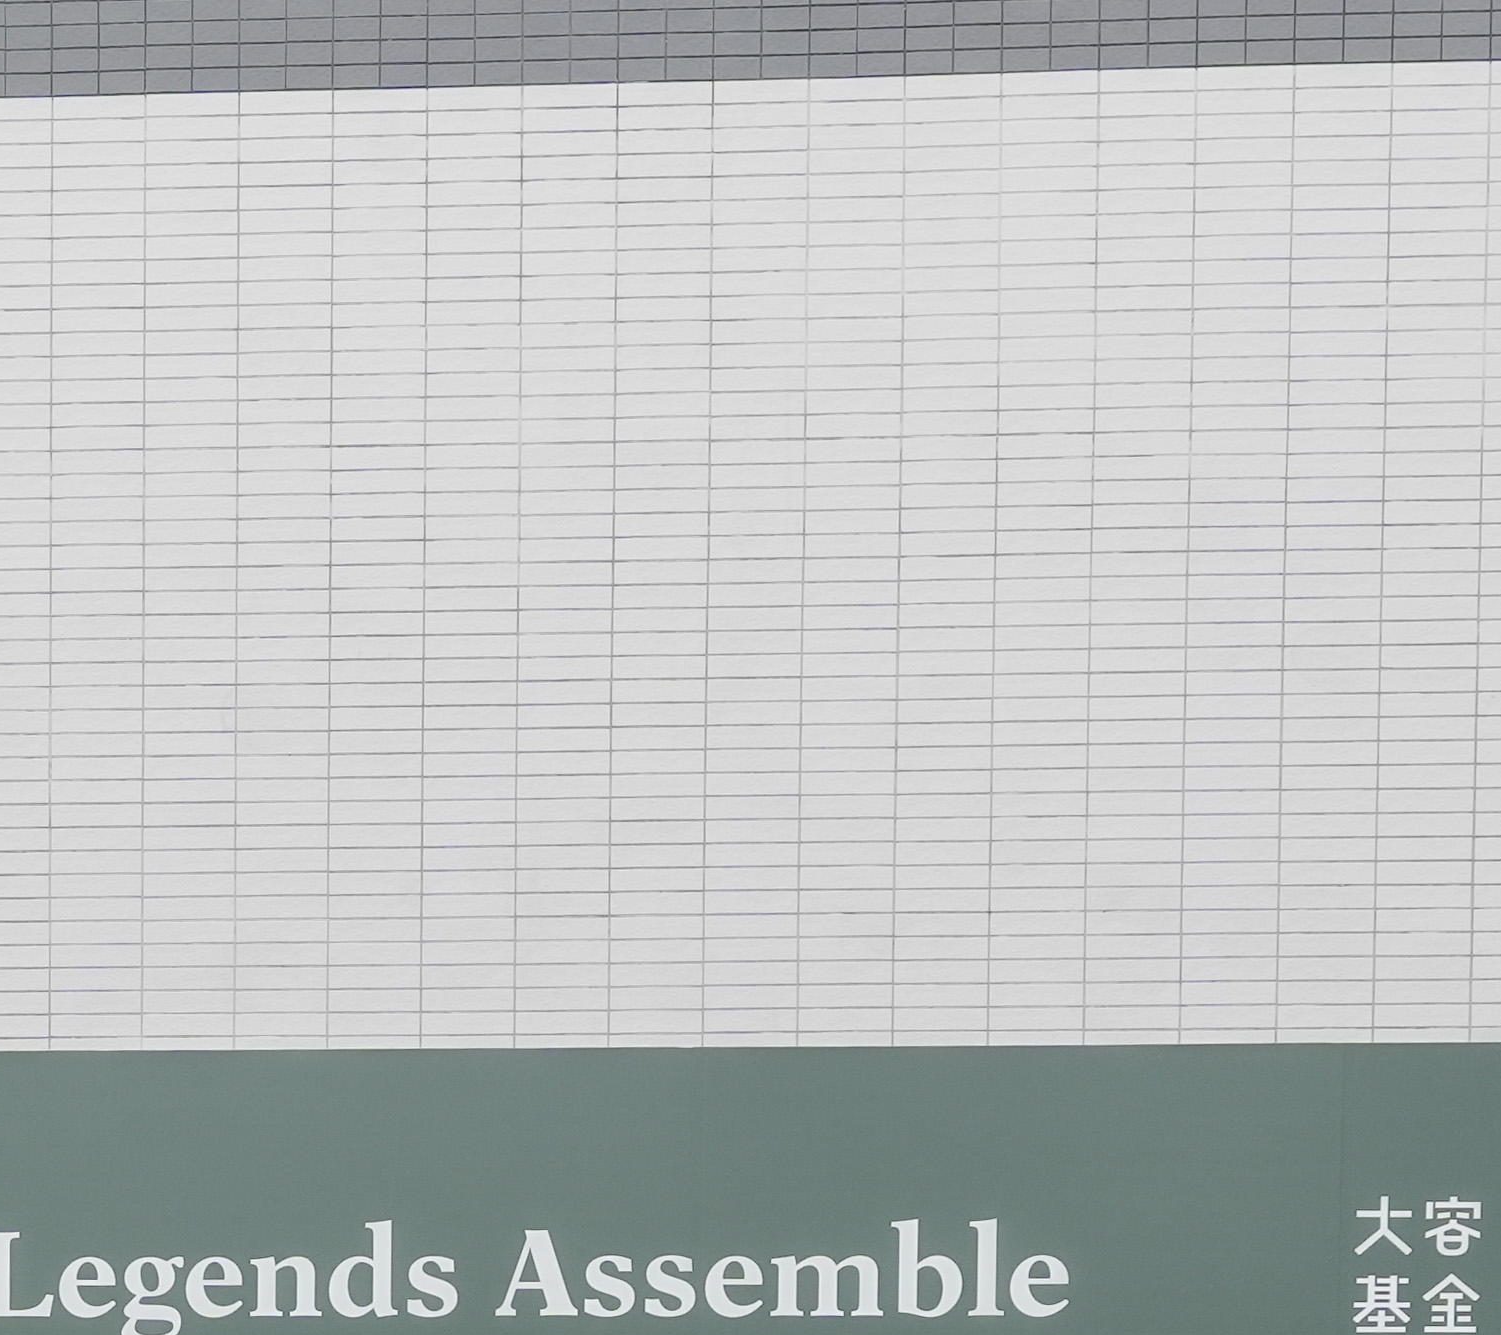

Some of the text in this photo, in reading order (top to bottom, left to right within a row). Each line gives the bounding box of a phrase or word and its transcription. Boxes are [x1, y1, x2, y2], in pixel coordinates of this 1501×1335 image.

[1354, 1195, 1482, 1257] 大容
[494, 1218, 1070, 1318] Assemble
[1352, 1273, 1480, 1334] 基金
